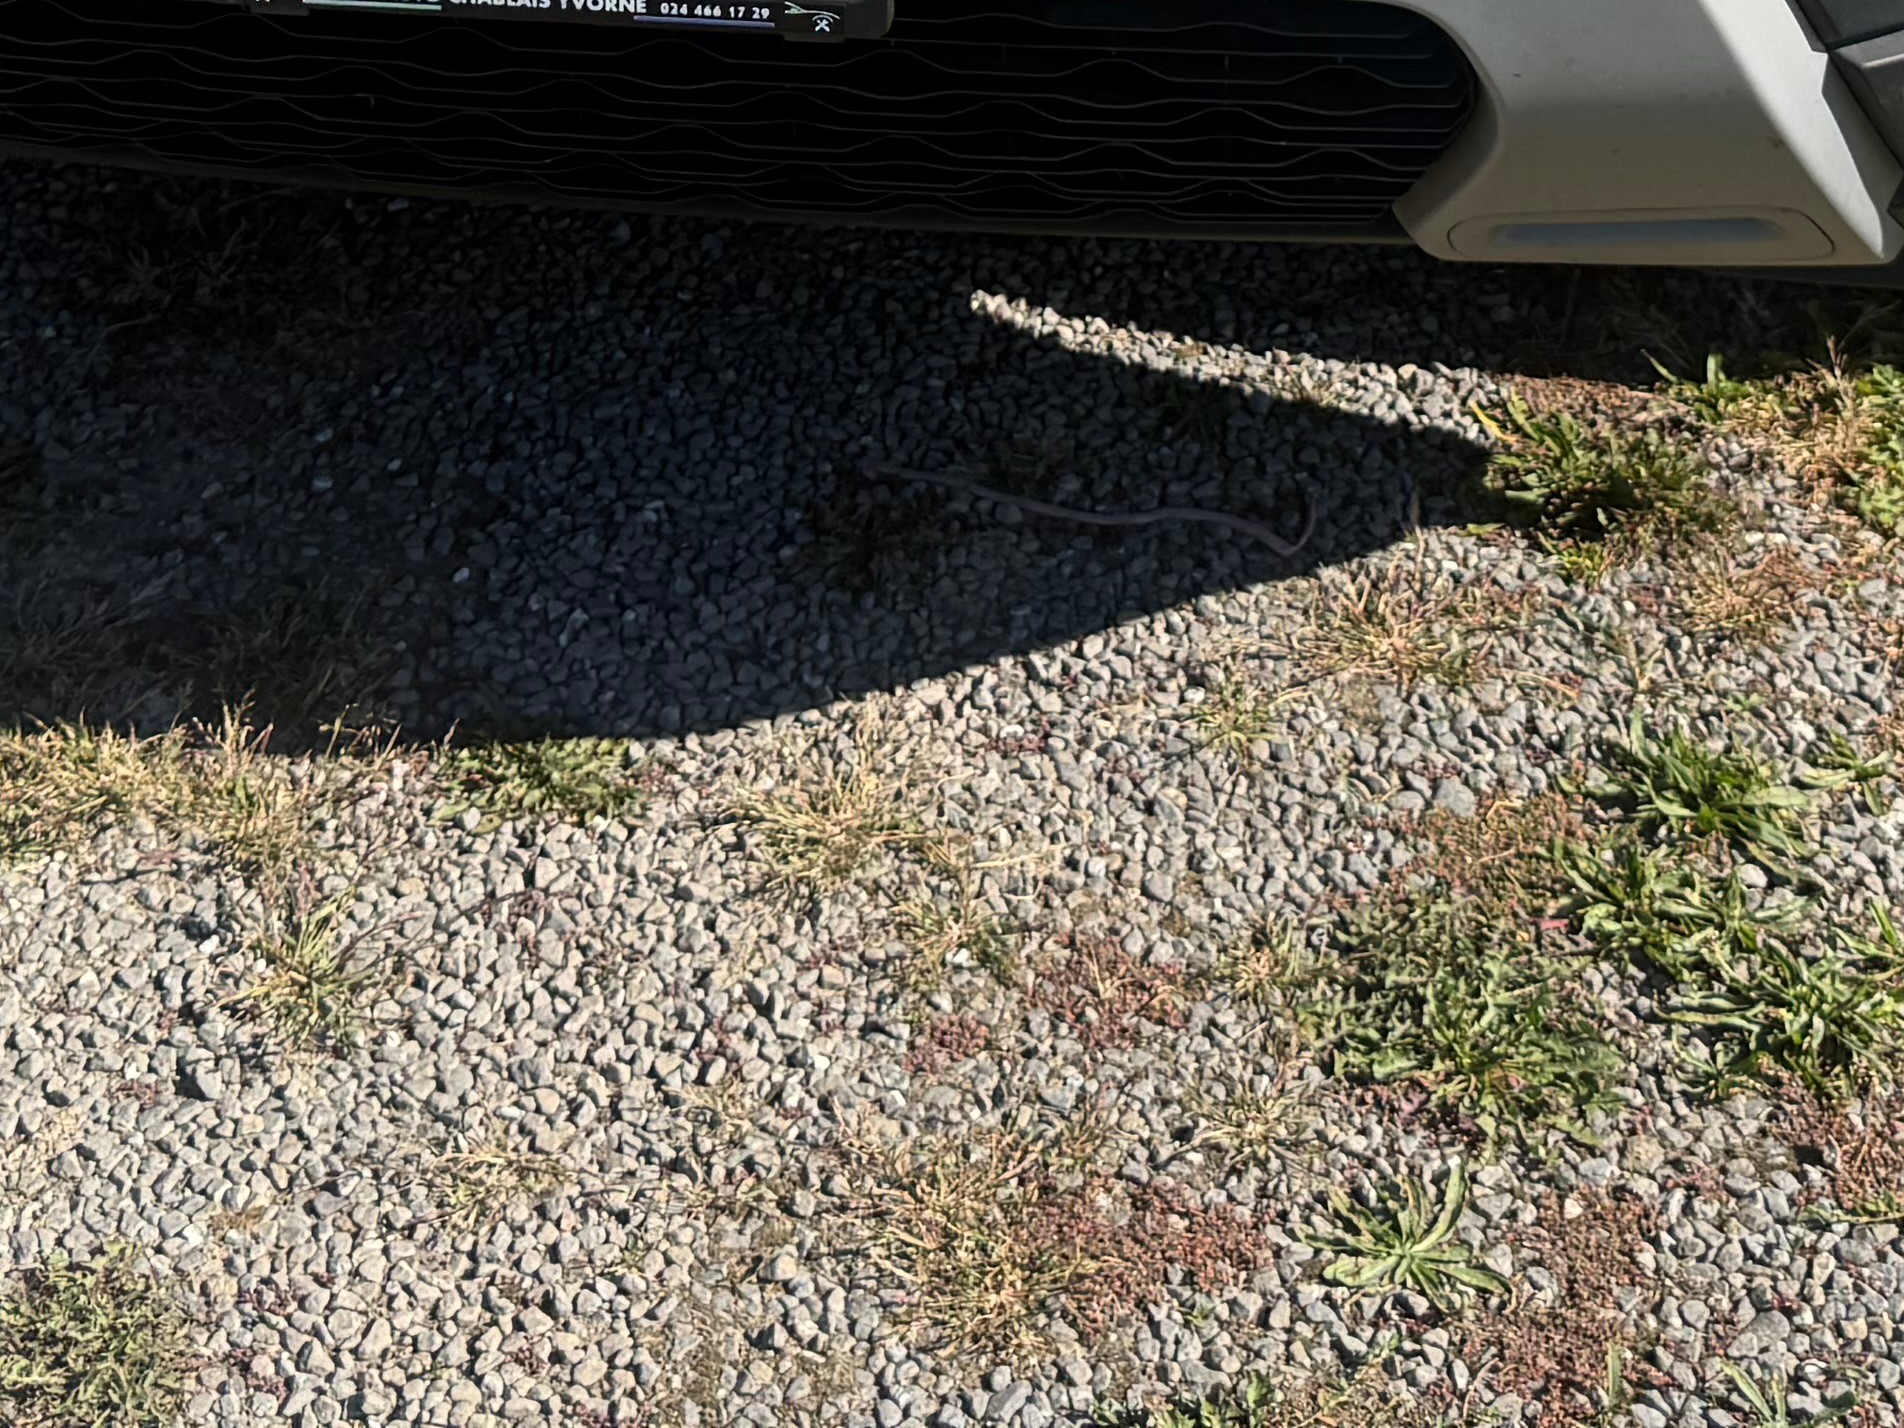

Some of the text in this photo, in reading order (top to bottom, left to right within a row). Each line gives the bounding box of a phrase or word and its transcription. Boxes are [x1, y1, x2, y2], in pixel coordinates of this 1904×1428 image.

[660, 2, 689, 16] 024
[693, 3, 722, 18] 466
[728, 5, 746, 19] 17
[751, 6, 771, 20] 29
